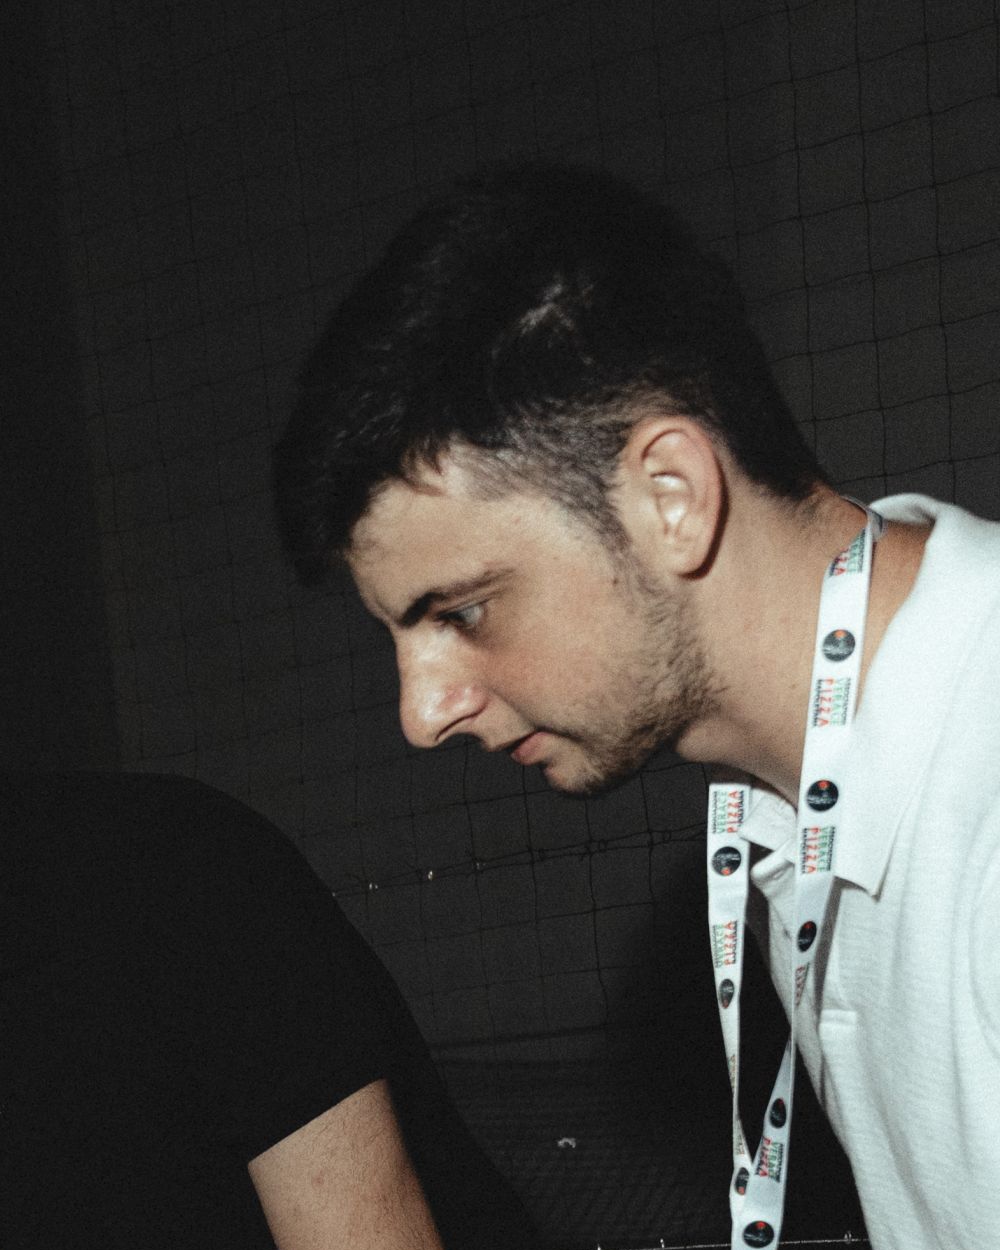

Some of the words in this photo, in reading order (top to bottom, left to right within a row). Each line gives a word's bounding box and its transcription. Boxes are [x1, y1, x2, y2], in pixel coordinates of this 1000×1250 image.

[817, 678, 834, 726] PIZZA
[727, 790, 740, 833] PIZZA
[806, 827, 820, 874] PIZZA
[817, 827, 829, 872] VERACE
[723, 922, 735, 965] PIZZA
